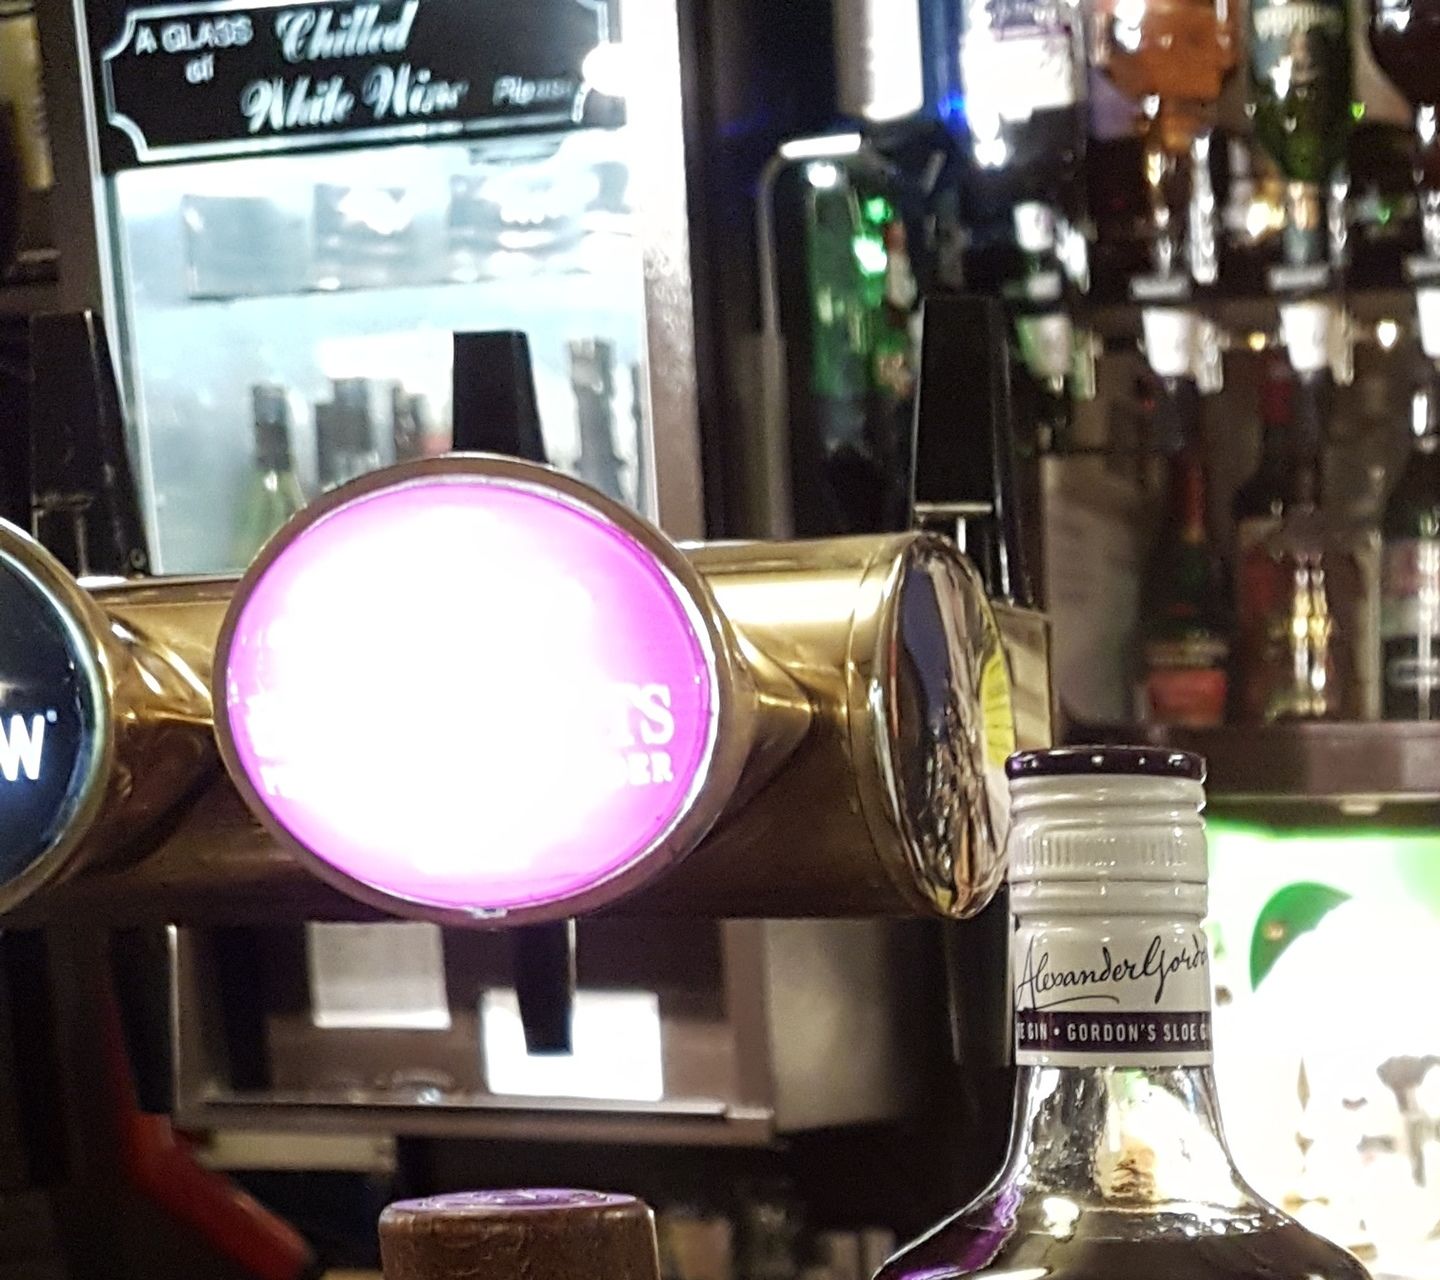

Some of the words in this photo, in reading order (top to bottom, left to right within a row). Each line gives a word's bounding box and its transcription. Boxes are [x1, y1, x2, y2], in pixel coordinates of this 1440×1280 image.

[134, 26, 158, 55] A
[162, 16, 255, 53] GLASS
[274, 0, 418, 64] Chilled
[241, 76, 356, 134] White
[361, 64, 468, 119] Wine
[1066, 1023, 1157, 1042] GORDON'S
[1163, 1023, 1196, 1041] SLOE
